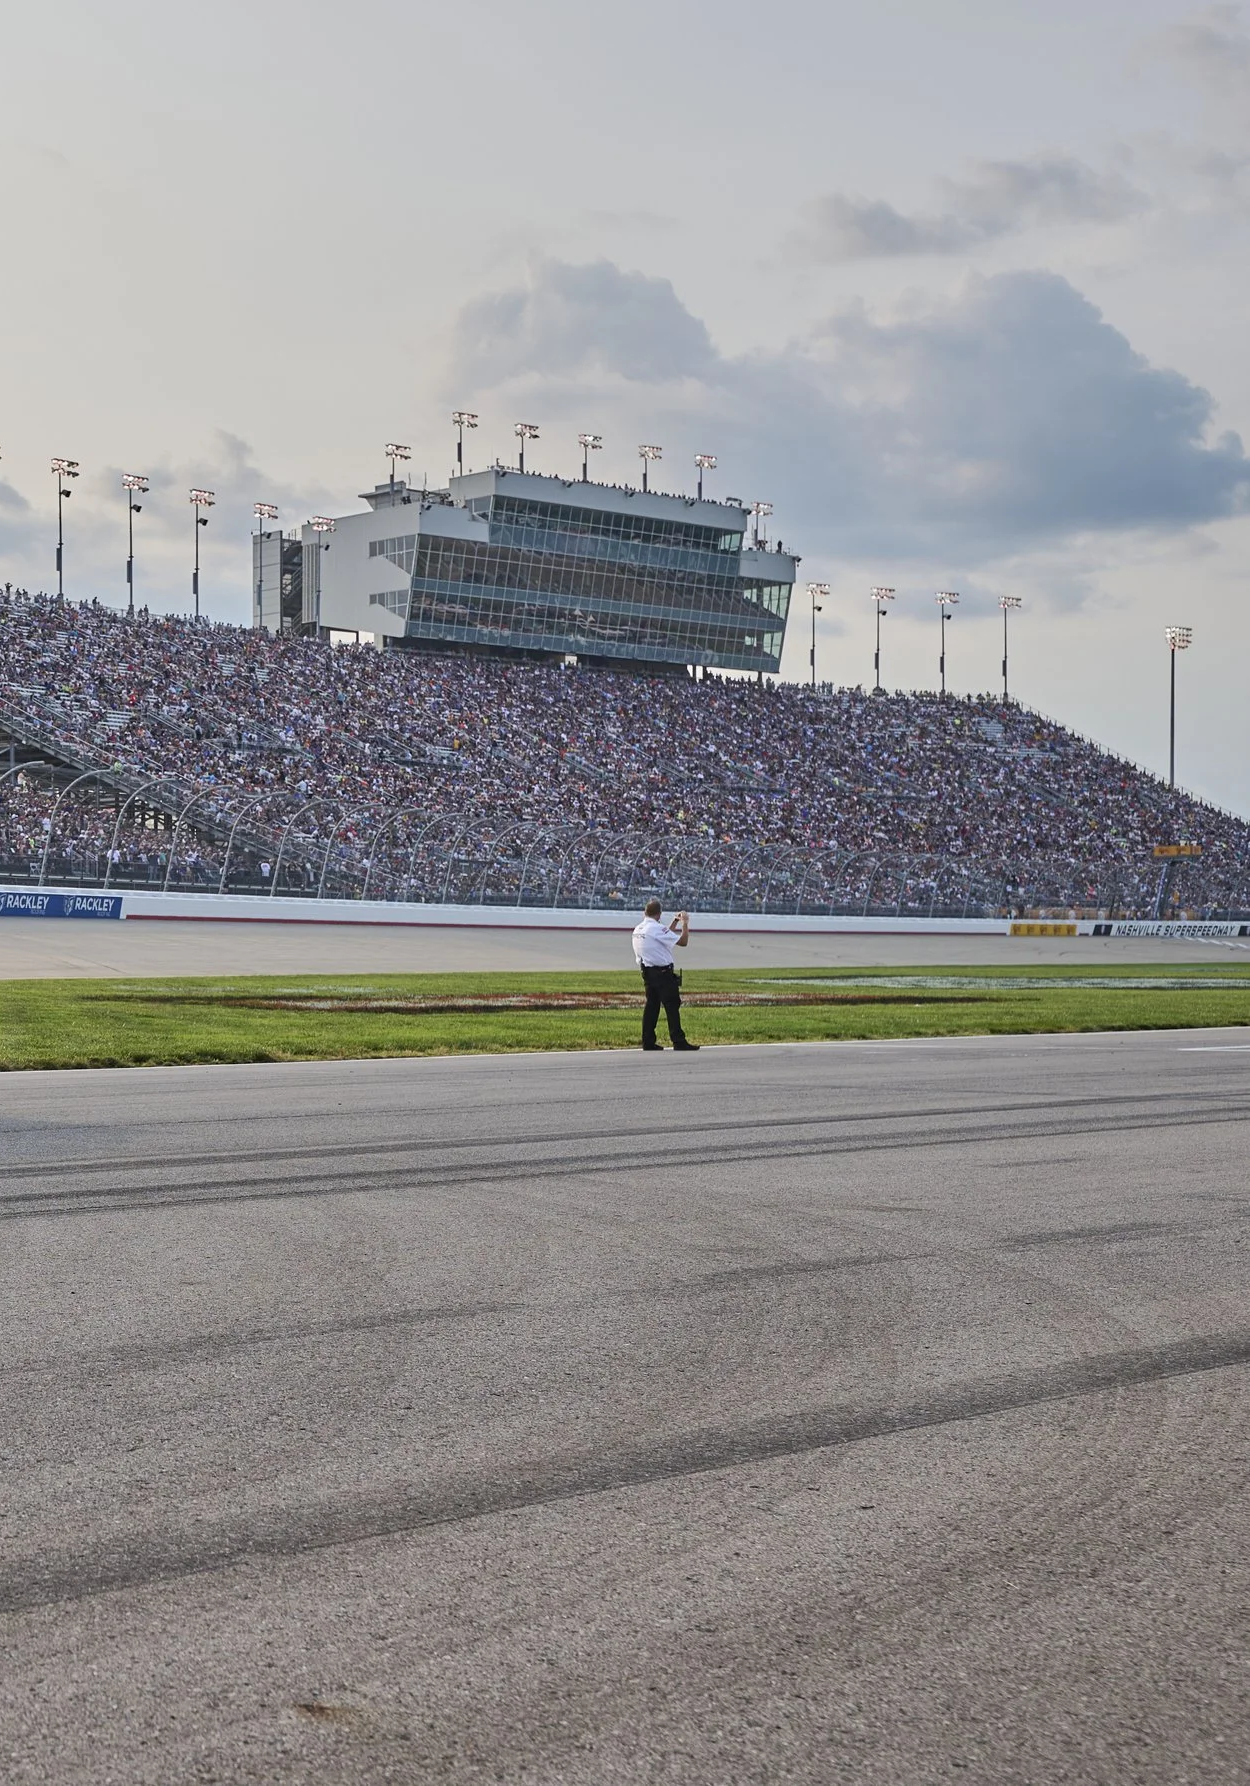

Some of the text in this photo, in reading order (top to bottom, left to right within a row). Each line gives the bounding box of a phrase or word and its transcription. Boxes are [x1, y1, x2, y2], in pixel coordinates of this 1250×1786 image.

[7, 895, 49, 909] RACKLEY
[75, 897, 115, 911] RACKLEY
[1116, 925, 1235, 937] NASHVILLE SUPERSPEEDWAY
